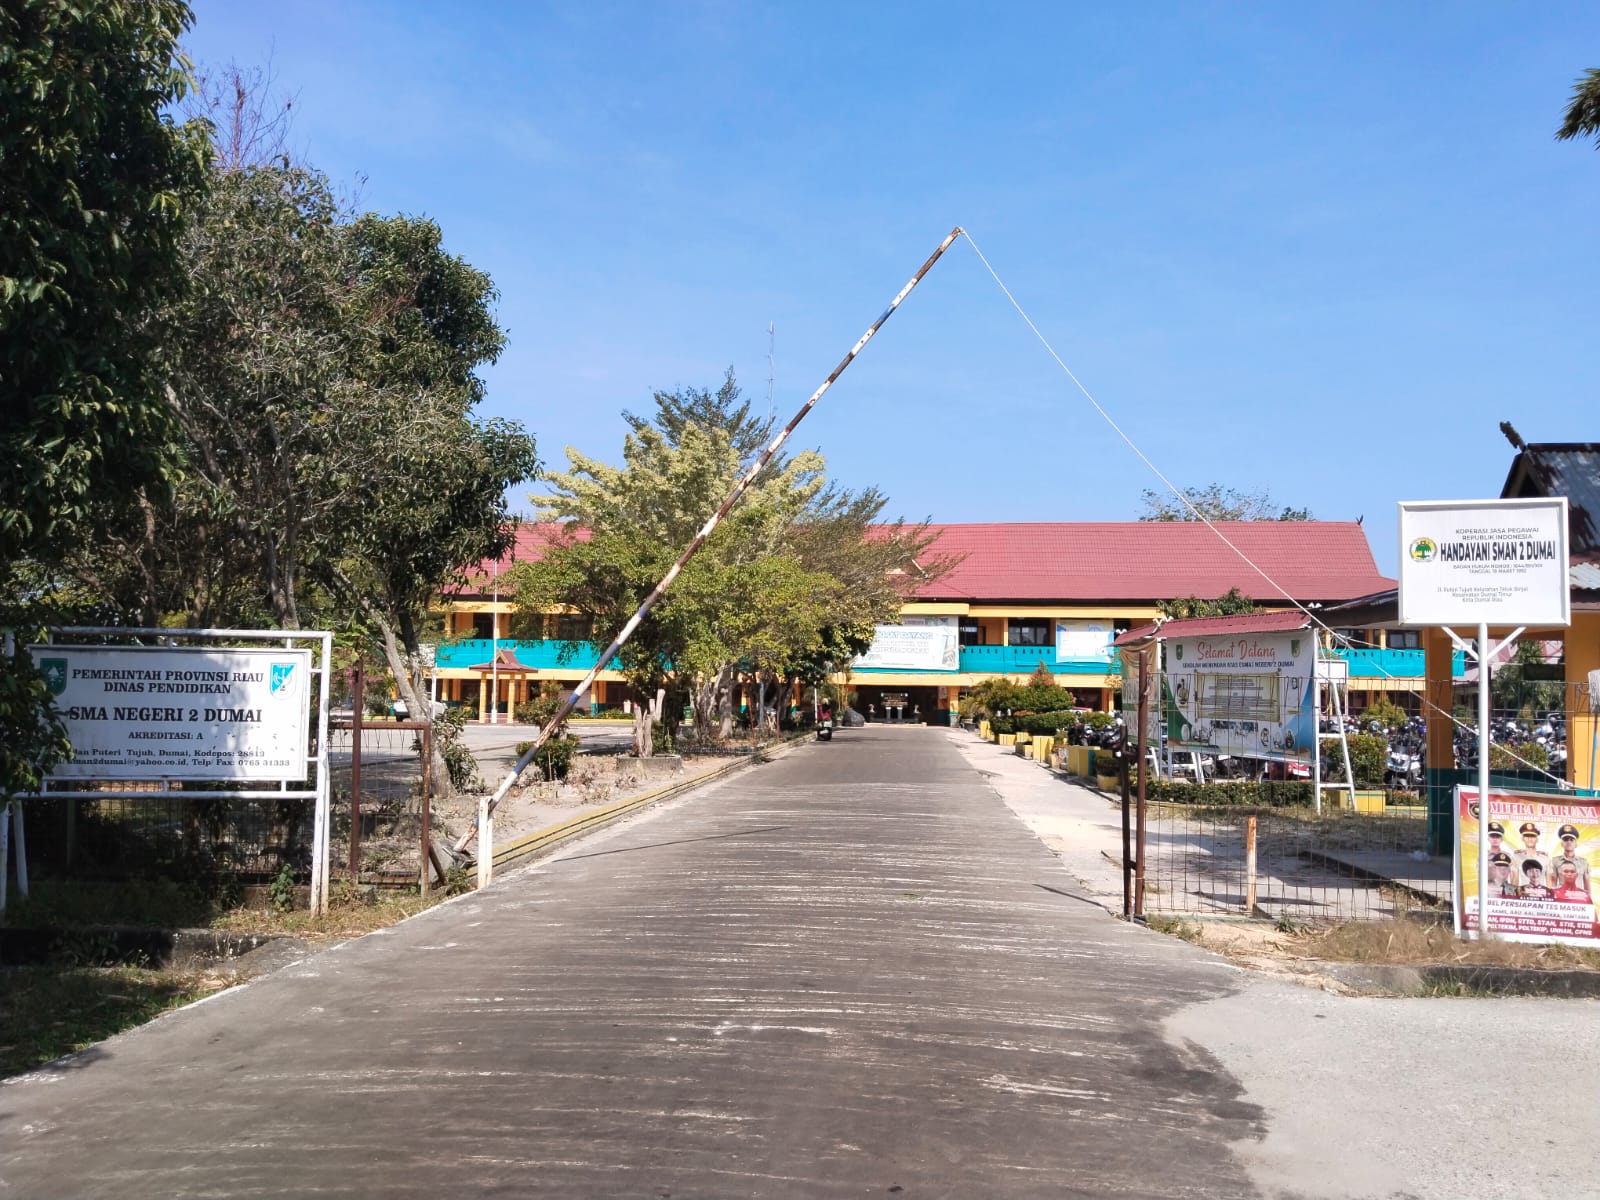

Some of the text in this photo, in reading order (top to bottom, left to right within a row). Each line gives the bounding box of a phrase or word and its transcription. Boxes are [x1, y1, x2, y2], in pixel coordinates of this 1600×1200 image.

[1440, 540, 1556, 562] HANDAYANI SMAN 2 DUMAI
[1197, 640, 1276, 661] Selamat Datang
[72, 669, 264, 683] PEMERINTAH PROVINSI RIAU
[103, 681, 232, 695] DINAS PENDIDIKAN
[68, 706, 262, 724] SMA NEGERI 2 DUMAI
[128, 731, 204, 740] AKREDITASI: A
[92, 748, 121, 756] Puteri
[126, 748, 156, 758] Tujuh,
[159, 749, 191, 758] Dumai,
[194, 749, 235, 759] Kodepos:
[1490, 801, 1535, 815] MITRA
[1537, 803, 1599, 819] TARUNA
[1500, 900, 1544, 910] PERSIAPAN
[1545, 903, 1559, 911] TES
[1559, 904, 1587, 913] MASUK
